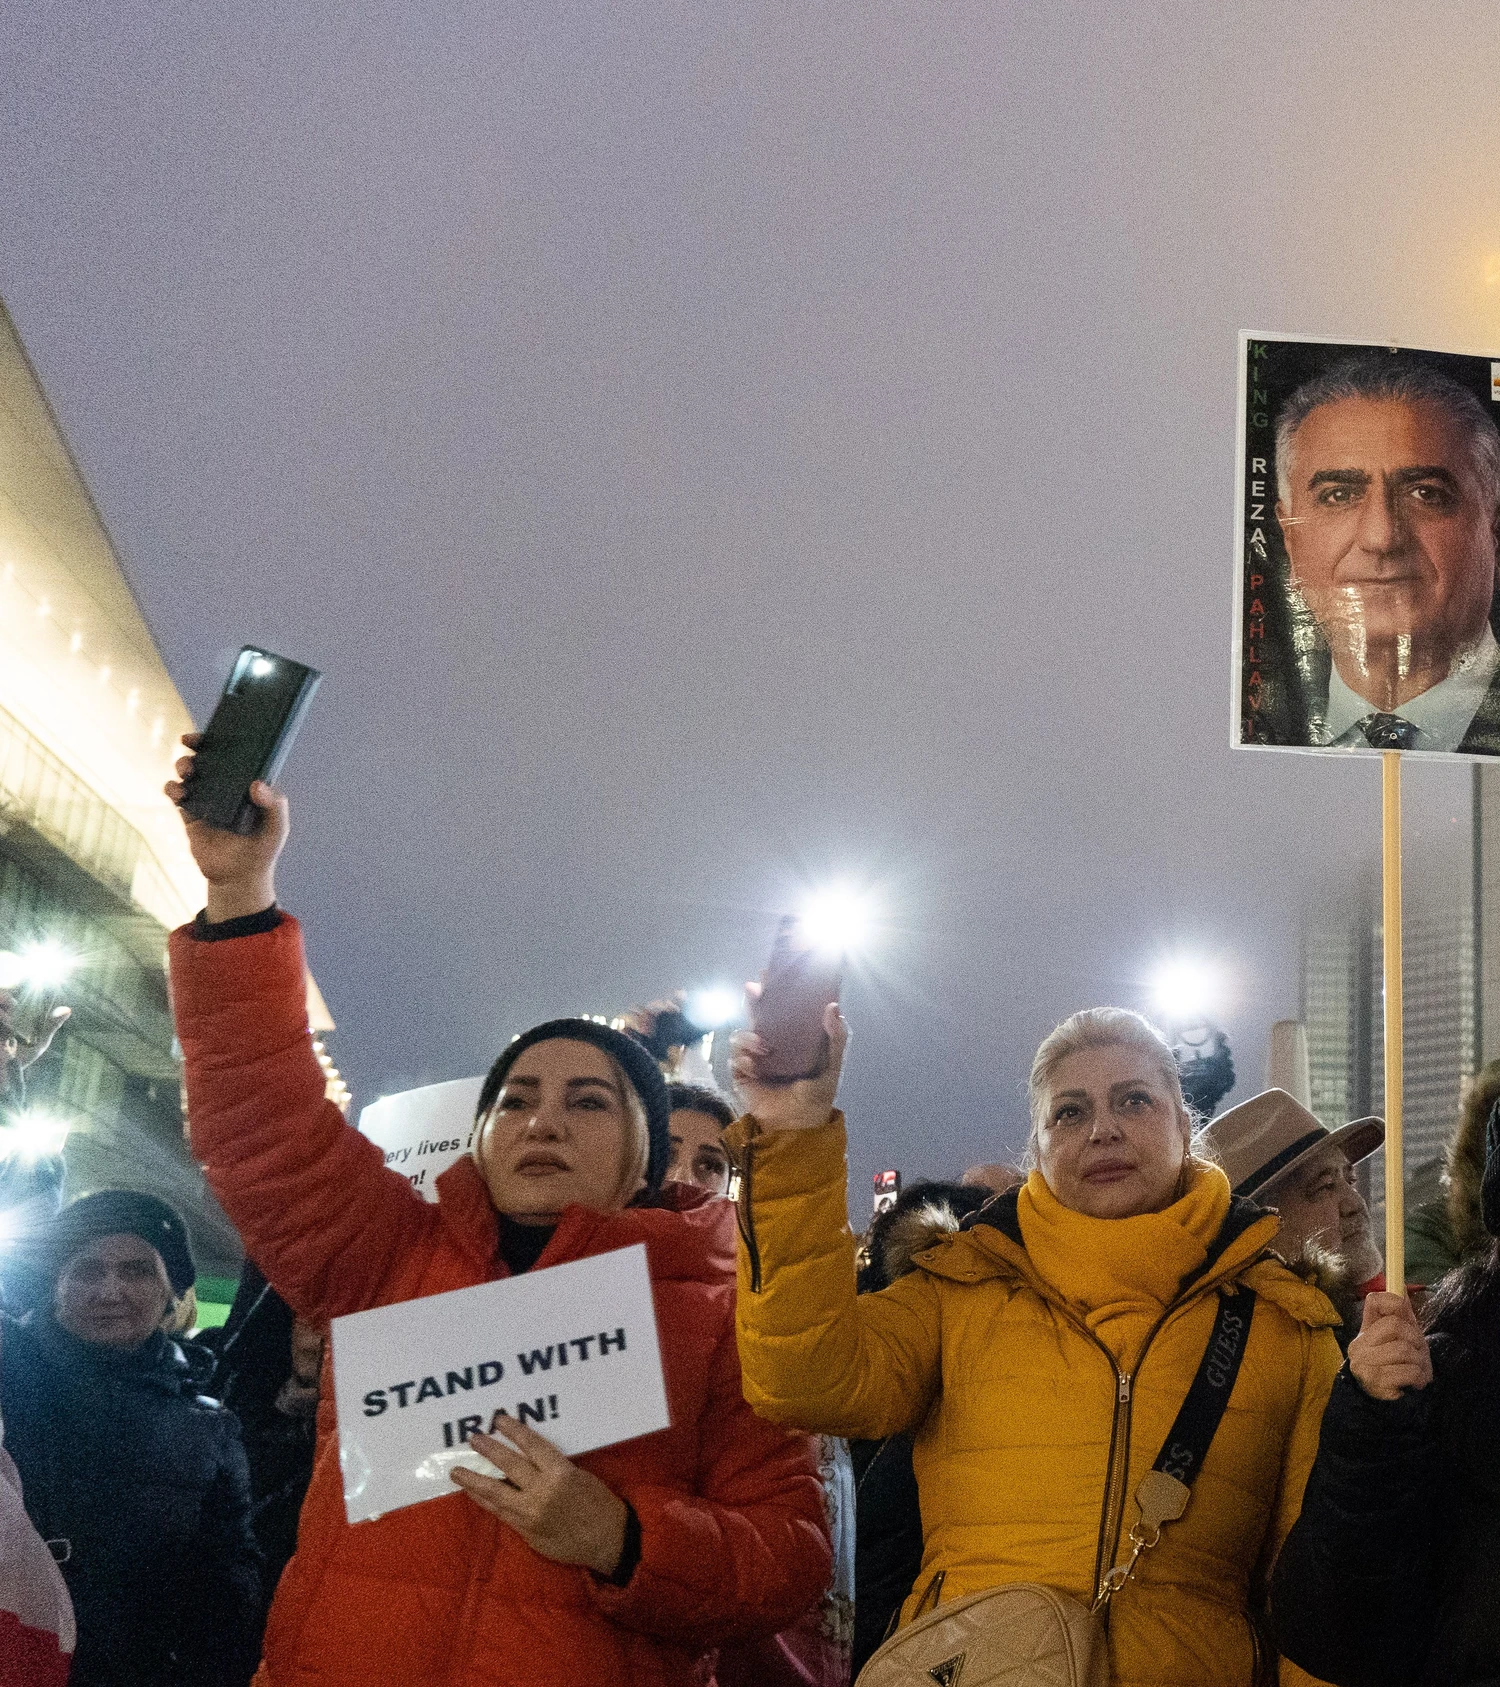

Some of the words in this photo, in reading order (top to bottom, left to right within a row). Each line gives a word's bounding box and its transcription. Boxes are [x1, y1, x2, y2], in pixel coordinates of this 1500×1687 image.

[1253, 344, 1268, 428] KING
[1251, 457, 1267, 544] REZA
[1249, 574, 1265, 736] PAHLAVI
[384, 1147, 412, 1163] ery
[417, 1138, 461, 1156] lives
[409, 1169, 426, 1186] n!
[362, 1360, 504, 1417] STAND
[517, 1328, 627, 1375] WITH
[1206, 1310, 1243, 1388] GUESS
[442, 1394, 560, 1448] IRAN!
[1162, 1442, 1194, 1481] SS
